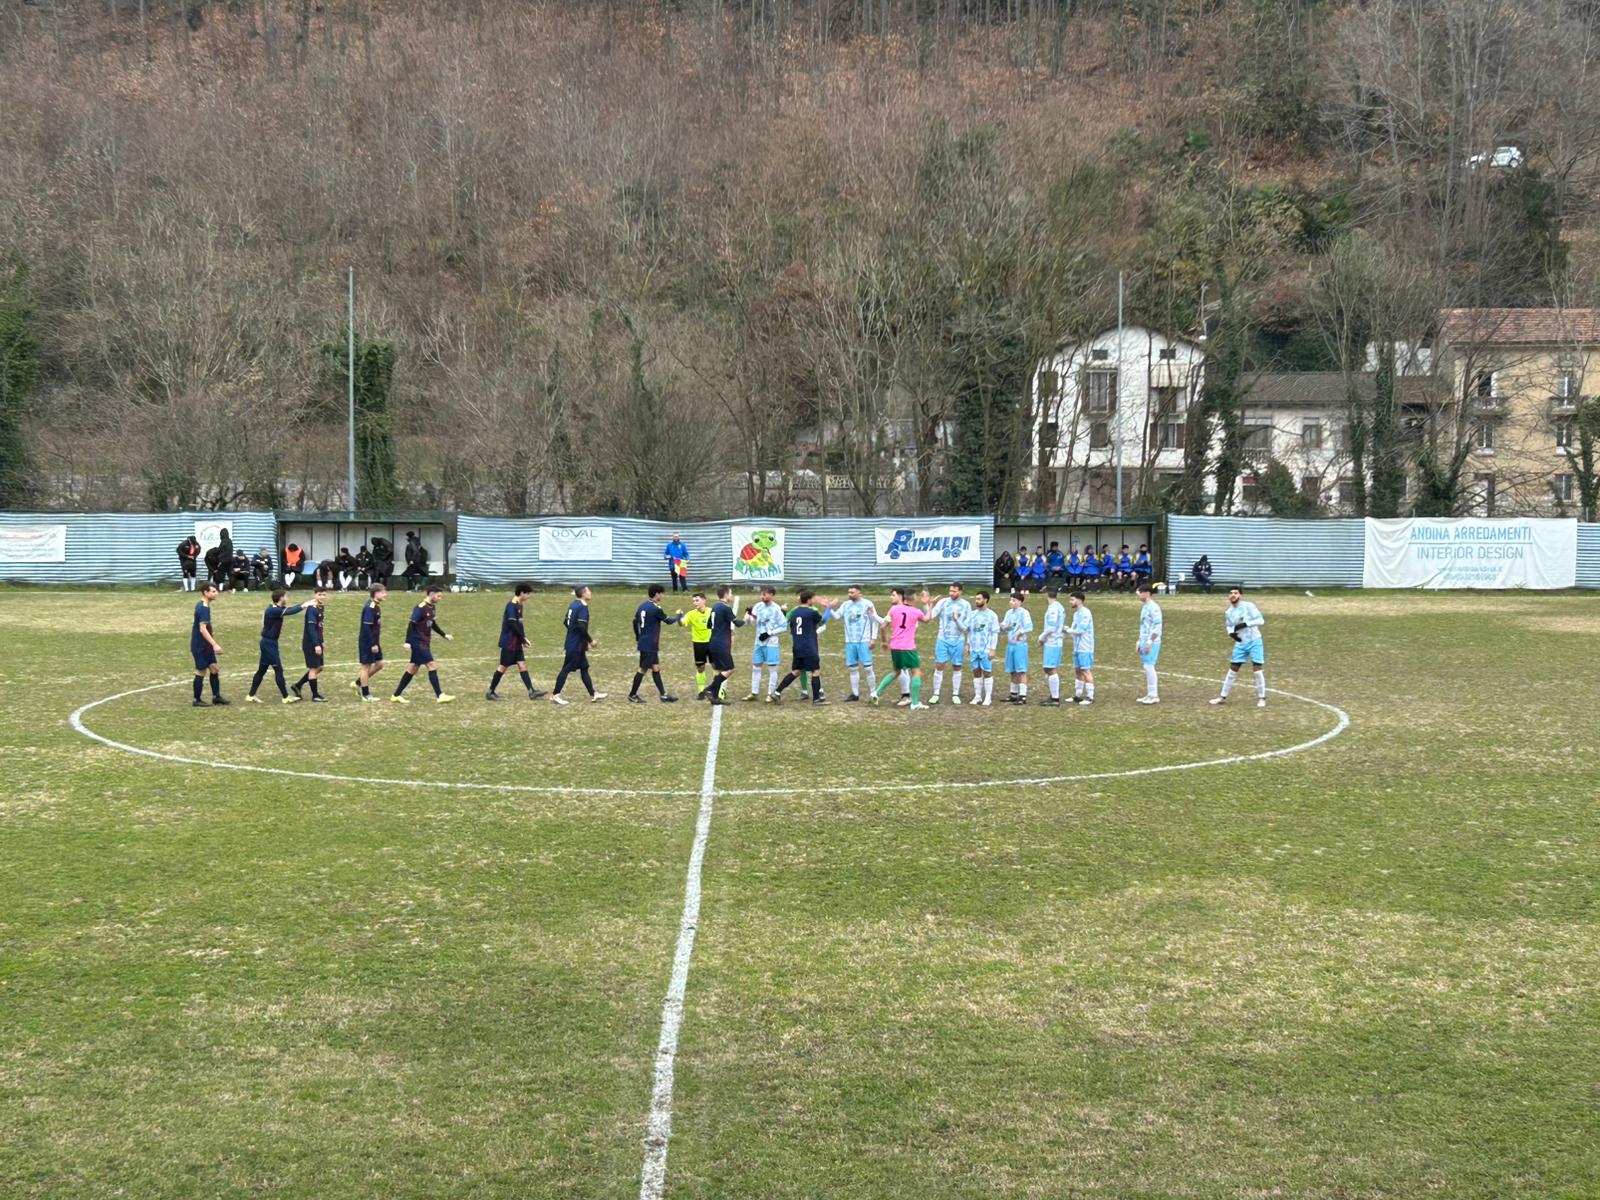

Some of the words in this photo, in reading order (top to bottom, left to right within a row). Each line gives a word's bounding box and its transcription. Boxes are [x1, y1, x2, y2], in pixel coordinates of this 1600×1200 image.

[885, 530, 971, 552] RINALDI
[1411, 527, 1450, 540] ANDINA
[1454, 526, 1531, 540] ARREDAMENTI
[1417, 546, 1473, 559] INTERIOR
[1478, 546, 1523, 559] DESIGN
[796, 617, 803, 635] 2
[899, 612, 907, 629] 1
